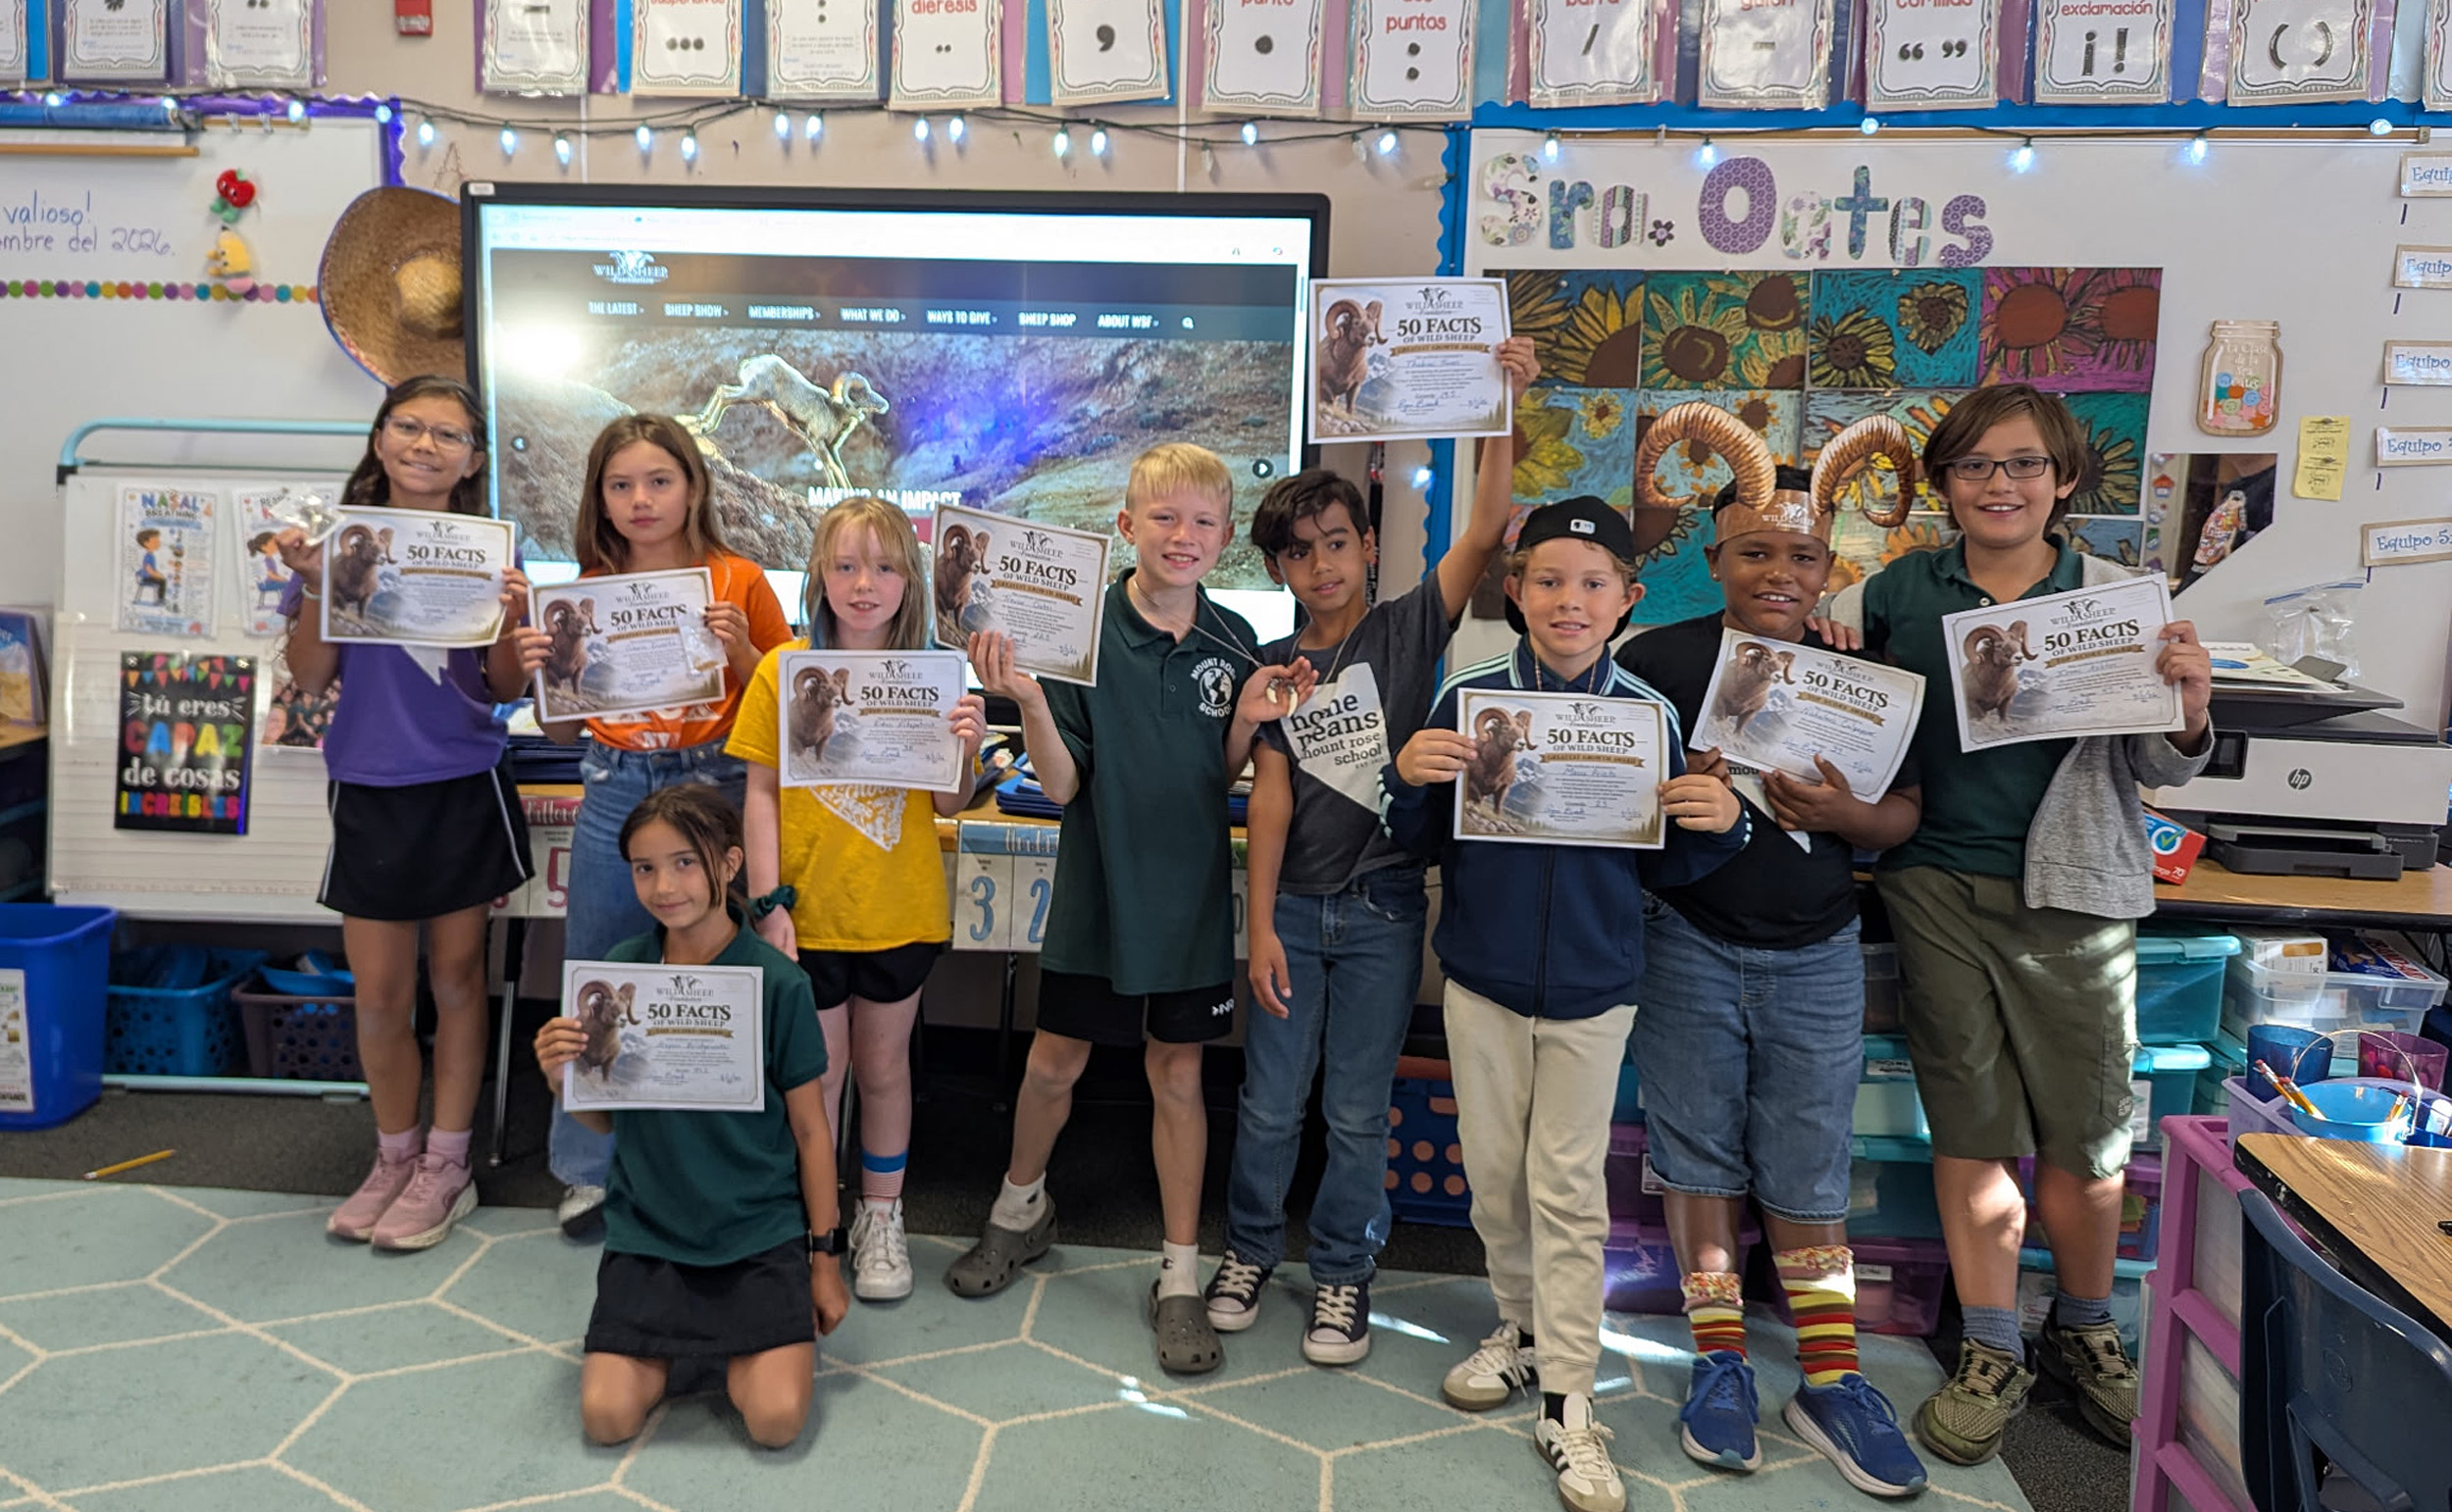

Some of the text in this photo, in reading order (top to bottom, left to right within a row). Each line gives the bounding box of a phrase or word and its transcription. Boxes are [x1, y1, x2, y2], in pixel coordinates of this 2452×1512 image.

[2061, 1, 2153, 17] exclamación
[1385, 13, 1448, 31] puntos
[3, 189, 92, 227] valioso!
[1699, 155, 1995, 268] Oates
[0, 226, 54, 252] mbre
[69, 226, 98, 252] del
[607, 303, 638, 315] LATEST
[664, 304, 722, 317] SHEEP SHOW
[748, 306, 814, 320] MEMBERSHIPS
[842, 309, 899, 322] WHAT WE DO
[927, 310, 991, 325] WAYS TO GIVE
[1019, 312, 1076, 326] SHEEP SHOP
[1098, 314, 1130, 328] ABOUT
[1397, 317, 1482, 336] 50 FACTS
[2395, 353, 2451, 371] Equipo
[2387, 437, 2442, 456] Equipo
[141, 492, 199, 513] NASAL
[2376, 534, 2433, 554] Equipo
[407, 545, 486, 564] 50 FACTS
[998, 555, 1077, 585] 50 FACTS
[1016, 574, 1040, 585] WILD
[1042, 579, 1070, 592] SHEEP
[610, 610, 632, 628] 50
[2050, 607, 2117, 626] WILD SHEEP
[2044, 619, 2140, 652] 50 FACTS
[2069, 642, 2097, 654] WILD
[2099, 637, 2134, 648] SHEEP
[1190, 658, 1218, 680] MOUNT
[860, 686, 940, 702] 50 FACTS
[1803, 671, 1889, 709] 50 FACTS
[1807, 686, 1880, 713] OF WILD SHEEP
[143, 692, 232, 718] tú eres
[1556, 713, 1616, 724] WILD SHEEP
[125, 719, 245, 757] CAPAZ
[1349, 731, 1382, 748] rose
[1547, 729, 1635, 748] 50 FACTS
[1334, 742, 1382, 766] school
[124, 756, 241, 789] de cosas
[2289, 769, 2310, 789] hp
[547, 847, 572, 908] 5
[969, 876, 1052, 943] 3 2
[647, 1004, 732, 1021] 50 FACTS
